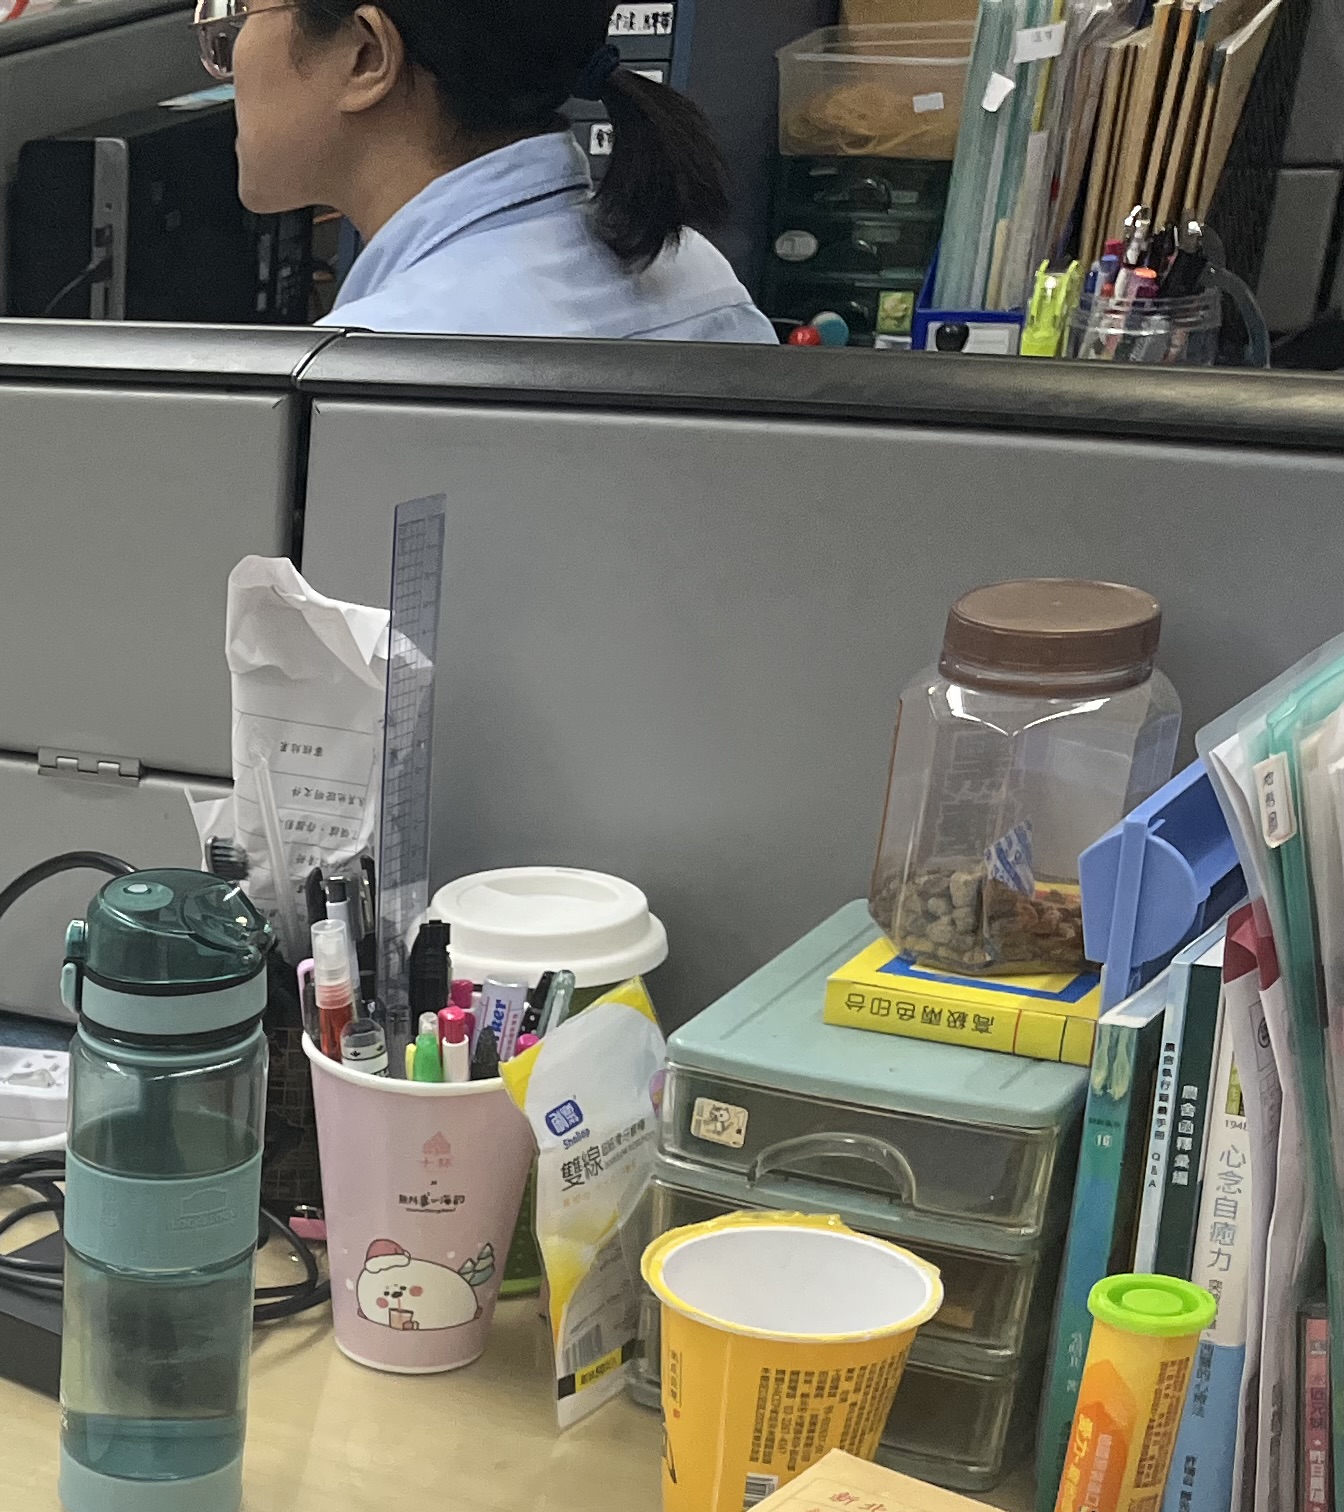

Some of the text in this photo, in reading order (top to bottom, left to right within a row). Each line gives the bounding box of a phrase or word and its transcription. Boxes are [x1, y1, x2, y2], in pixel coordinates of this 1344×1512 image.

[845, 993, 994, 1034] 高級兩色印台
[1207, 1145, 1247, 1272] 心念自癒力
